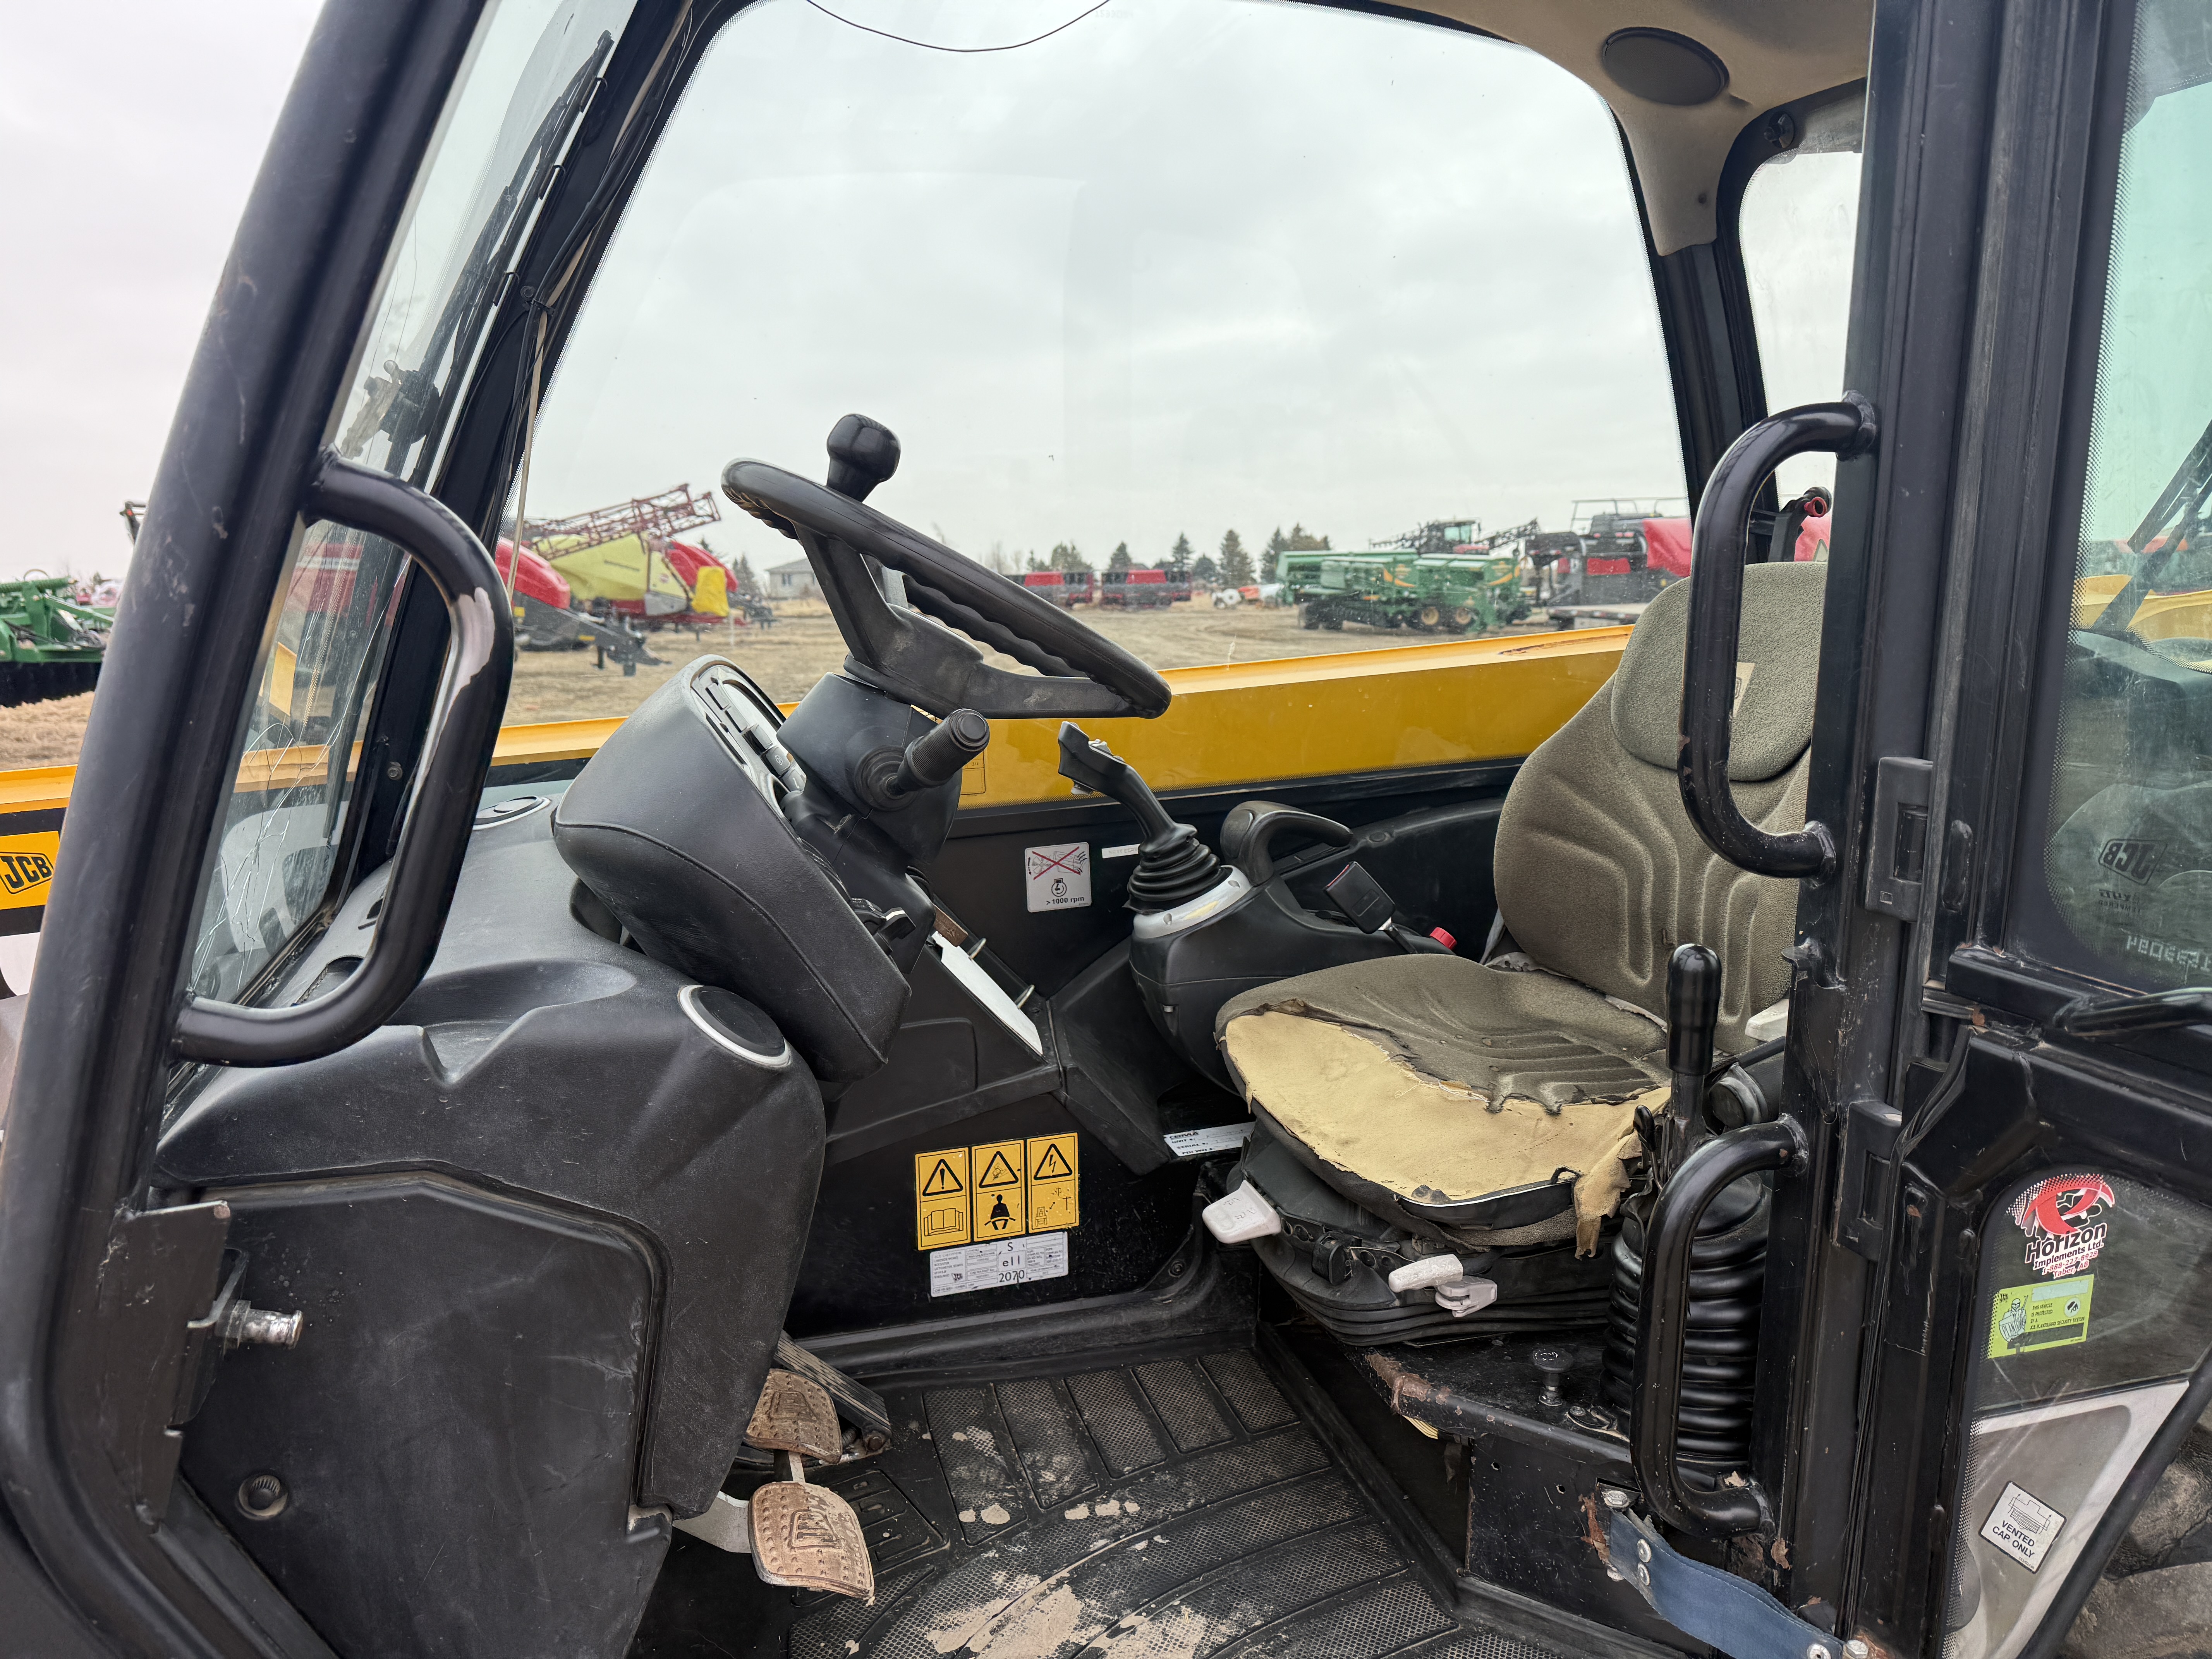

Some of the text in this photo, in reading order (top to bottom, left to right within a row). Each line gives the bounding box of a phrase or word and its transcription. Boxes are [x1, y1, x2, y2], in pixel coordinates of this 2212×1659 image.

[0, 856, 52, 889] JCB
[1007, 1242, 1013, 1251] S
[2026, 1224, 2106, 1262] Horizon
[2034, 1240, 2103, 1268] Implements Ltd.
[2043, 1250, 2098, 1273] 1-888-227-8928
[2054, 1267, 2076, 1277] Taber,
[1992, 1526, 2035, 1558] CAP ONLY
[2002, 1520, 2035, 1547] VENTED
